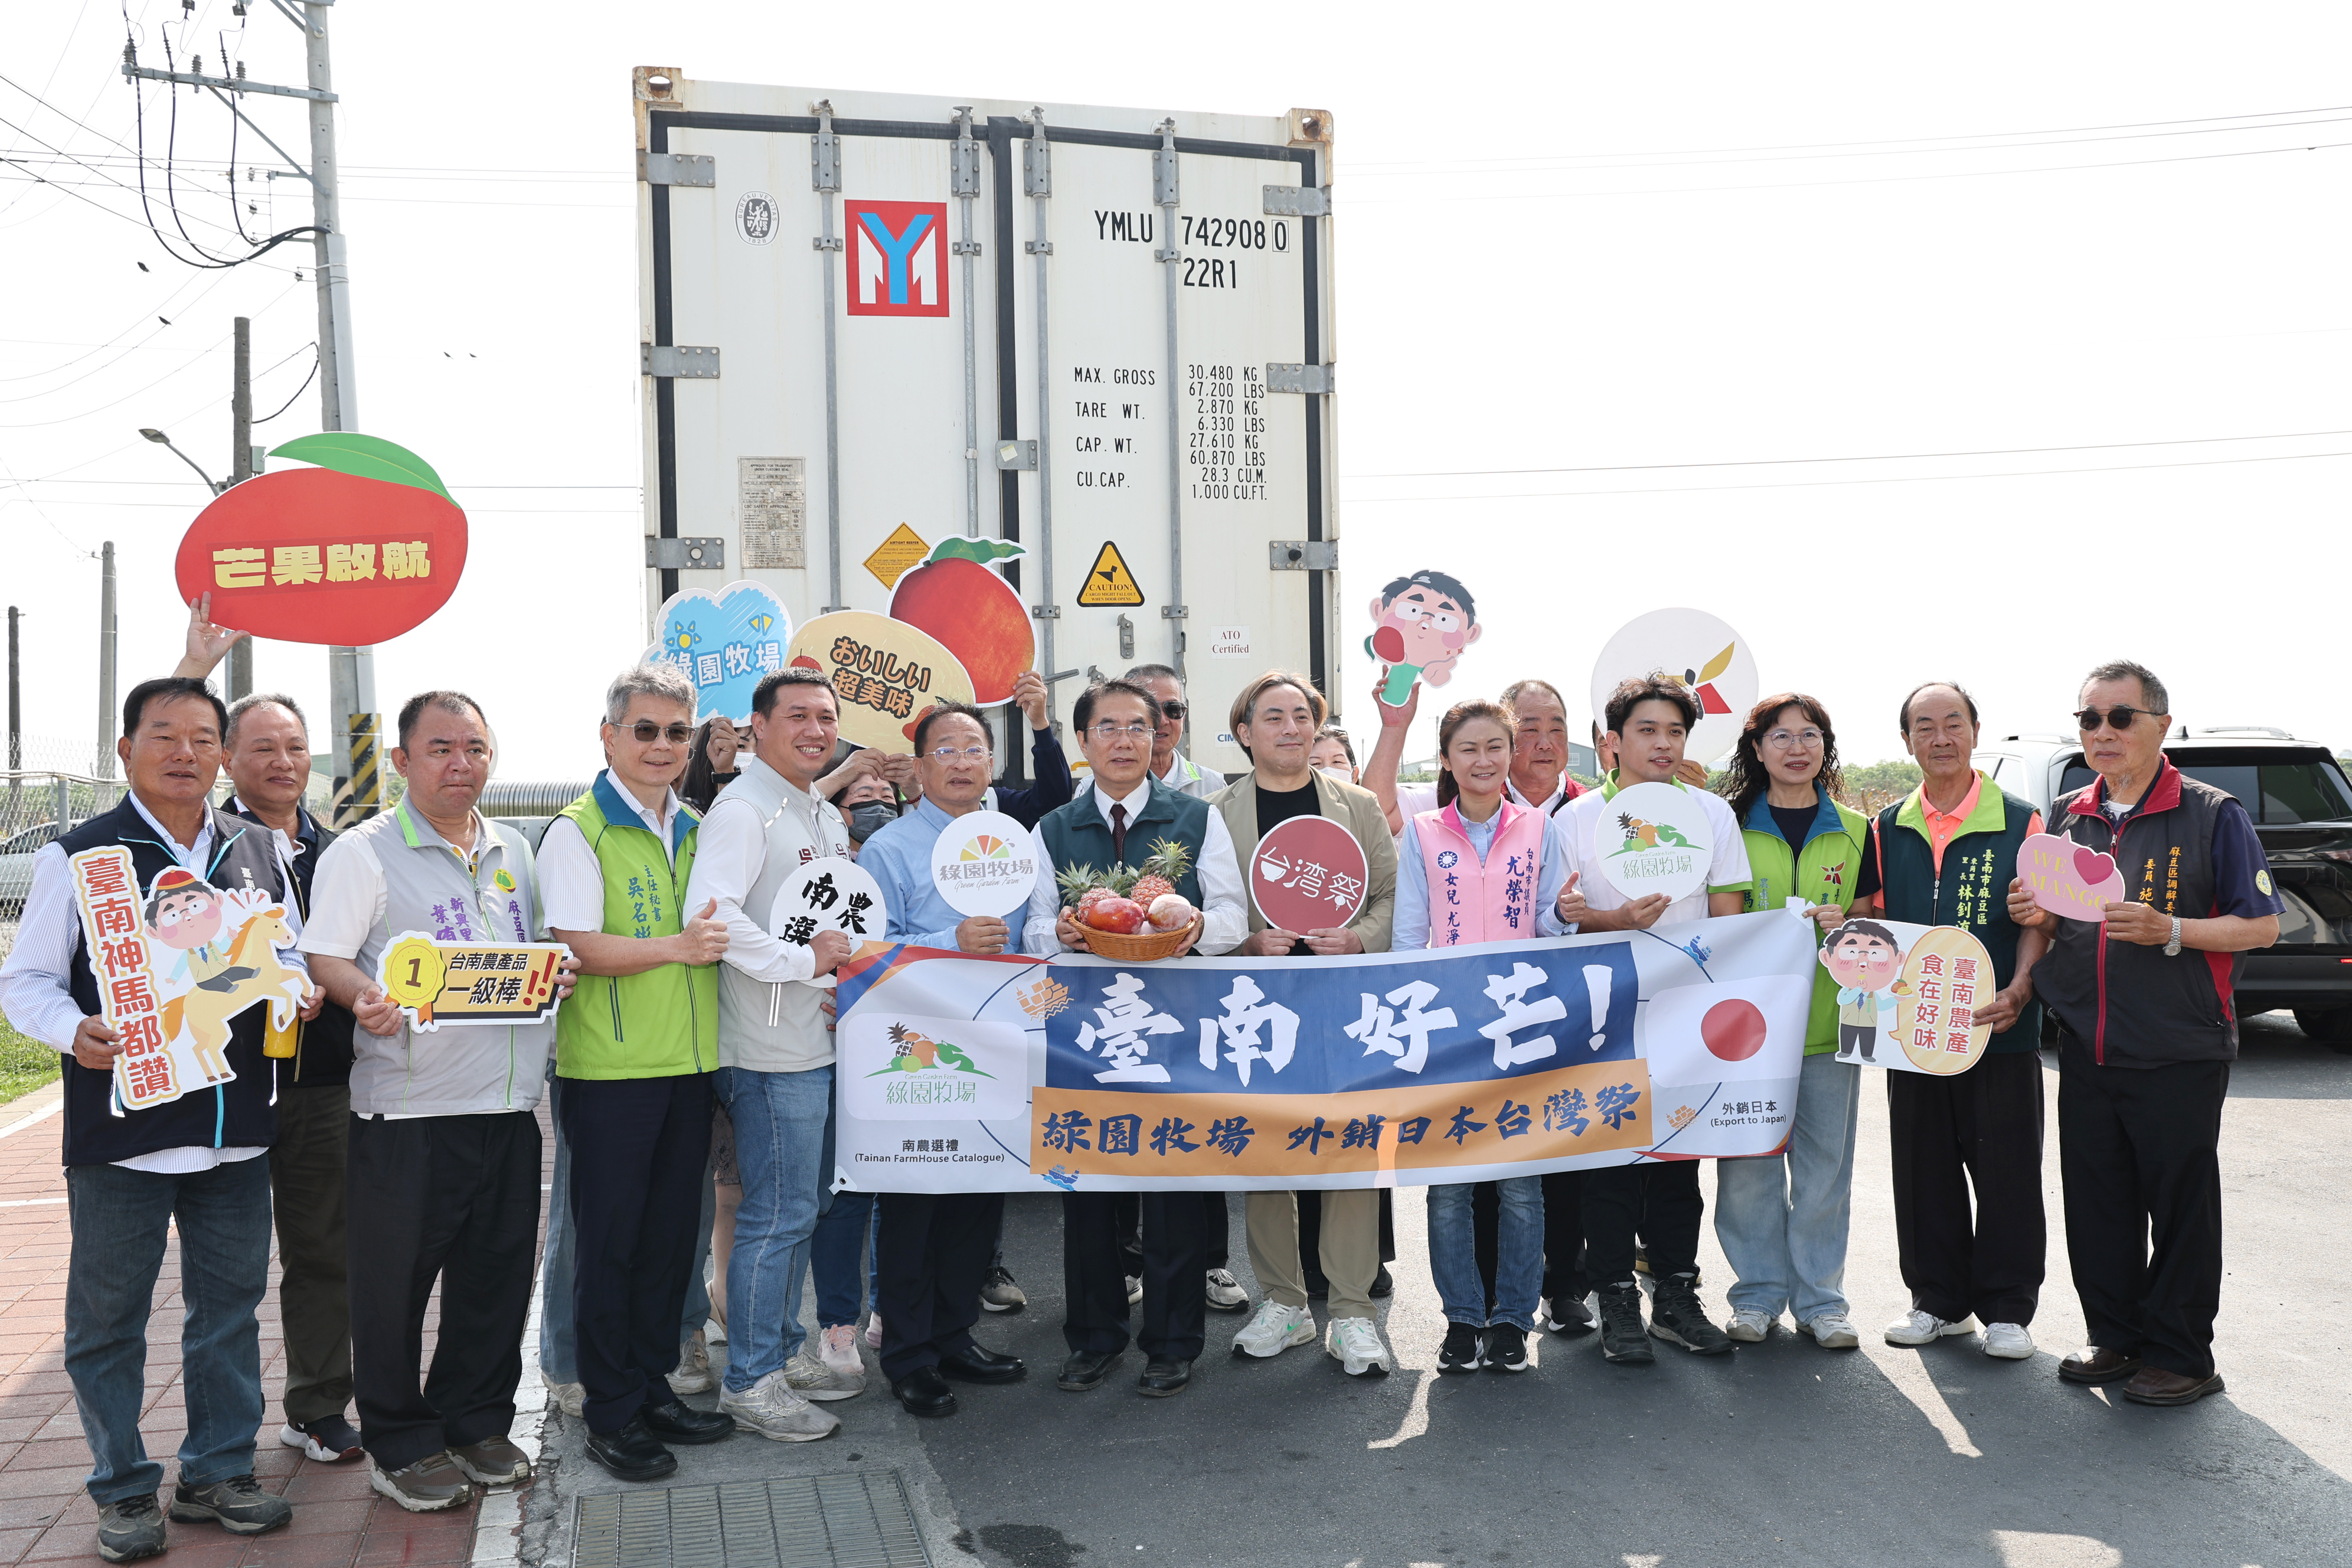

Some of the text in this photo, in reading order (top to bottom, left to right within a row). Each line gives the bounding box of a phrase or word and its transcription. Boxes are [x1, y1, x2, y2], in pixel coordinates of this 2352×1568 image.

[738, 192, 777, 221] BUREAU VERITAS
[1094, 210, 1153, 243] YMLU
[1181, 215, 1266, 250] 742908
[1183, 257, 1237, 289] 22R1
[1074, 366, 1156, 386] MAX. GROSS
[1188, 364, 1257, 382] 30,480 KG
[1188, 381, 1265, 399] 67,200 LBS
[1075, 401, 1145, 420] TARE WT.
[1197, 399, 1258, 416] 2,870 KG
[1197, 416, 1265, 433] 6,330 LBS
[1076, 436, 1137, 454] CAP. WT.
[1190, 433, 1259, 450] 27,610 KG
[1190, 450, 1266, 467] 60,870 LBS
[1076, 471, 1130, 489] CU.CAP.
[1201, 467, 1268, 484] 28.3 CU.M.
[1191, 484, 1268, 501] 1,000 CU.FT.
[212, 540, 431, 589] 芒果啟航
[1220, 630, 1241, 640] ATO
[1211, 644, 1250, 654] Certified
[831, 638, 930, 691] おいしい
[833, 668, 913, 717] 超美味
[1217, 734, 1236, 742] CIM
[939, 858, 1034, 881] 綠園牧場
[1622, 855, 1693, 880] 綠園牧場
[1968, 857, 1978, 881] 東角里
[2033, 848, 2067, 874] WE
[954, 876, 1020, 893] Green Garden Farm
[1260, 846, 1362, 912] 台湾祭
[1523, 848, 1534, 916] 台南市議員
[1977, 848, 1995, 925] 臺南市麻豆區
[643, 864, 662, 922] 主任秘書
[1502, 855, 1525, 929] 尤榮智
[2026, 871, 2111, 912] MANGO
[449, 897, 474, 942] 新興里
[405, 958, 422, 987] 1
[448, 951, 529, 971] 台南農產品
[81, 855, 174, 1100] 臺南神馬都讚
[1914, 953, 1945, 1050] 食在好味
[1945, 956, 1977, 1054] 臺南農產
[886, 1081, 976, 1105] 綠園牧場
[1721, 1099, 1778, 1116] 外銷日本
[1041, 1082, 1642, 1158] 綠園牧場 外銷日本台灣祭
[1710, 1117, 1745, 1128] (Export
[1760, 1113, 1786, 1125] Japan)
[901, 1139, 959, 1152] 南農選禮
[854, 1153, 1005, 1163] (Tainan FarmHouse Catalogue)
